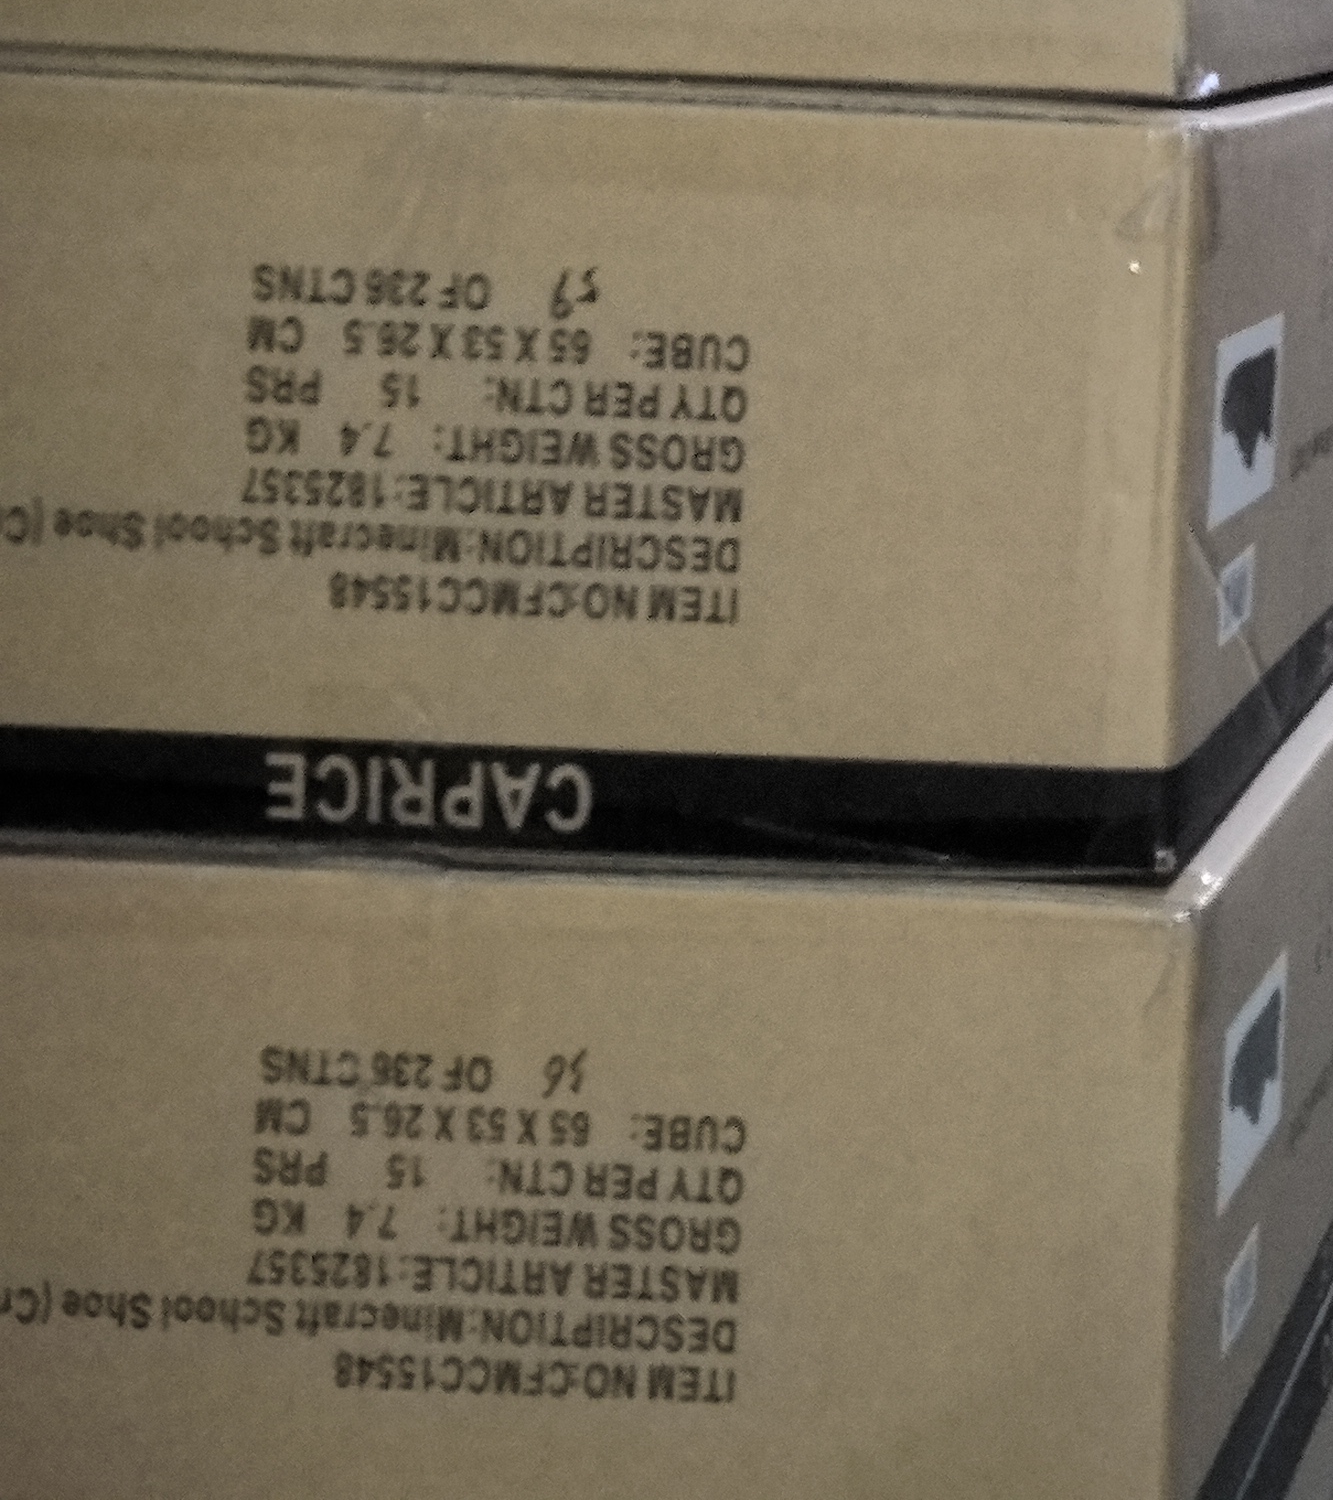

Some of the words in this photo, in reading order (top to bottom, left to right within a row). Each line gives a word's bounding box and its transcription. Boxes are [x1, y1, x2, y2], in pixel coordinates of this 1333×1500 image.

[252, 264, 356, 304] CTNS
[364, 268, 430, 307] 236
[438, 273, 490, 311] OF
[246, 316, 303, 353] CM
[344, 319, 420, 357] 26.5
[430, 324, 452, 358] X
[463, 325, 503, 360] 53
[516, 328, 538, 361] X
[550, 328, 590, 364] 65
[632, 331, 749, 372] CUBE:
[245, 365, 320, 405] PRS
[381, 372, 419, 407] 15
[487, 379, 571, 414] CTN:
[585, 382, 659, 418] PER
[671, 385, 747, 423] QTY
[246, 416, 298, 453] KG
[340, 424, 390, 458] 7.4
[433, 428, 595, 464] WEIGHT:
[611, 433, 745, 472] GROSS
[585, 484, 742, 522] MASTER
[53, 508, 145, 549] Shoe
[154, 513, 279, 555] School
[647, 586, 738, 624] ITEM
[264, 751, 594, 831] CAPRICE
[260, 1046, 362, 1087] CTNS
[370, 1051, 434, 1088] 236
[442, 1055, 492, 1092] OF
[254, 1098, 310, 1135] CM
[351, 1101, 423, 1138] 26.5
[435, 1107, 454, 1140] X
[467, 1106, 505, 1142] 53
[518, 1110, 536, 1144] X
[550, 1110, 589, 1146] 65
[632, 1114, 746, 1153] CUBE:
[253, 1147, 327, 1186] PRS
[388, 1154, 423, 1188] 15
[488, 1160, 572, 1195] CTN:
[585, 1163, 657, 1200] PER
[670, 1166, 743, 1205] QTY
[252, 1198, 304, 1235] KG
[346, 1205, 395, 1238] 7.4
[438, 1209, 595, 1245] WEIGHT:
[610, 1215, 740, 1254] GROSS
[586, 1265, 738, 1302] MASTER
[60, 1289, 152, 1329] Shoe
[161, 1295, 285, 1334] School
[647, 1365, 736, 1403] ITEM
